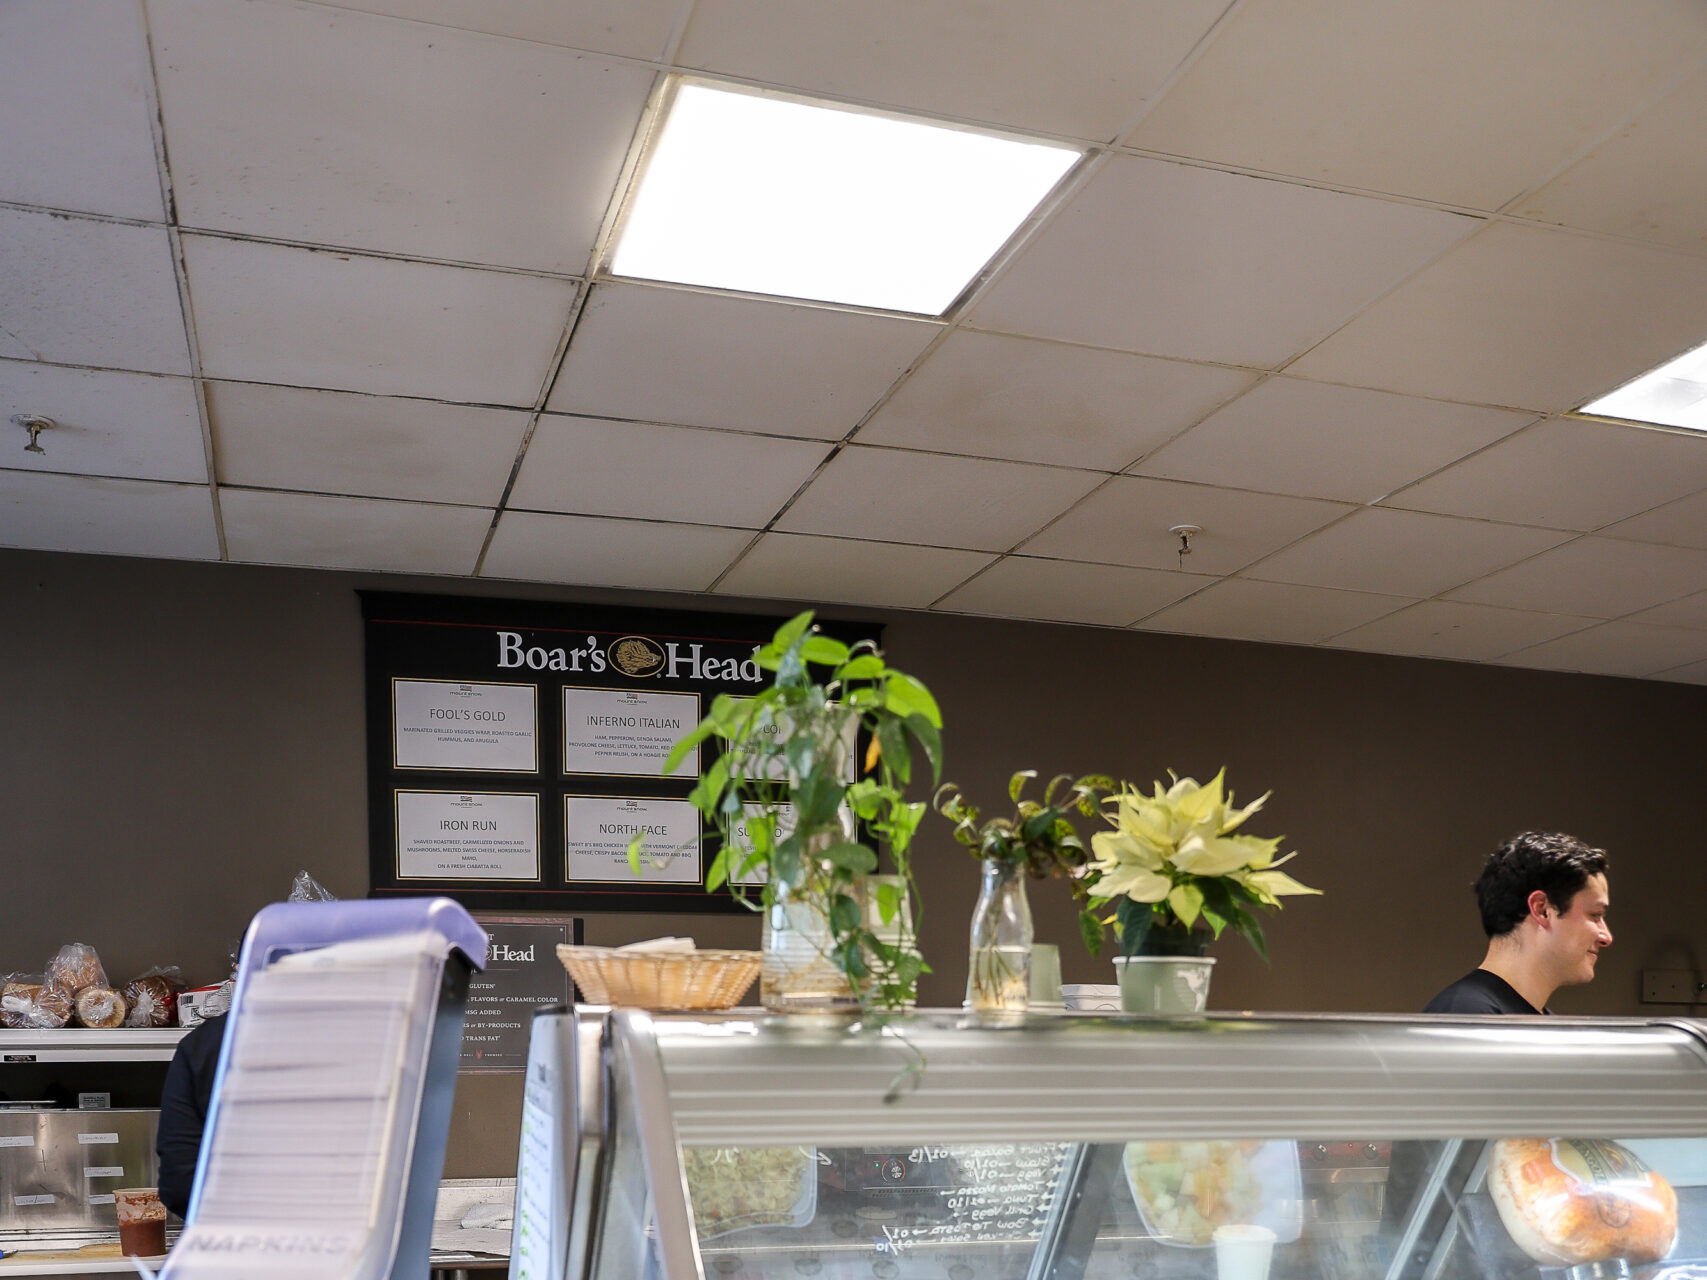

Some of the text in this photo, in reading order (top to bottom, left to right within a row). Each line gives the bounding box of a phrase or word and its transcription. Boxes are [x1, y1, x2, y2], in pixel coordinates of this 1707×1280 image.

[497, 631, 763, 683] Boar's Head
[430, 709, 505, 721] FOOL'S GOLD
[587, 715, 680, 729] INFERNO ITALIAN
[440, 820, 497, 831] IRON RUN
[599, 824, 667, 836] NORTH FACE
[492, 944, 535, 962] Head
[190, 1234, 347, 1253] NAPKINS
